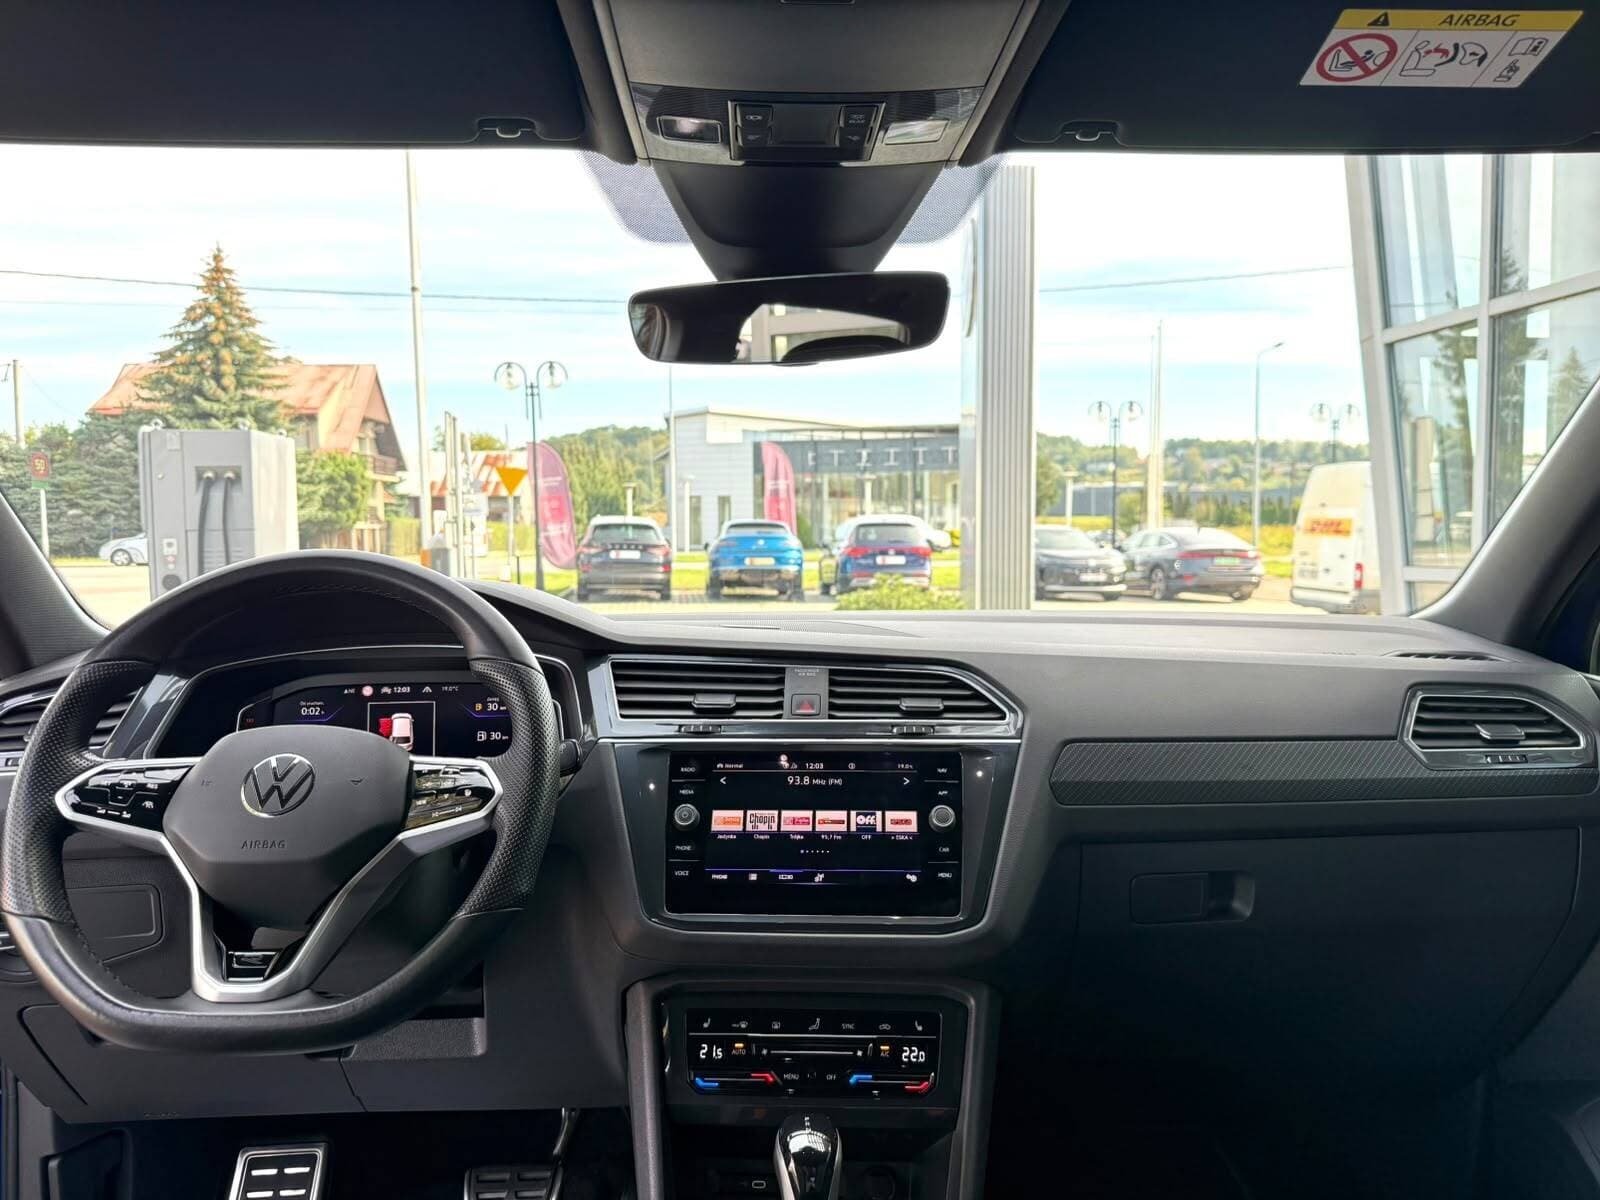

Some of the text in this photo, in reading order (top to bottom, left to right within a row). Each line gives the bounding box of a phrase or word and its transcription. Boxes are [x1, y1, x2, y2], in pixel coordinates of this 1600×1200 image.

[1438, 14, 1521, 27] AIRBAG
[1310, 519, 1343, 533] DHL
[393, 686, 411, 694] 12:03
[487, 702, 499, 711] 30
[301, 707, 321, 716] 0:02
[489, 731, 502, 740] 30
[787, 776, 810, 785] 93.8
[828, 778, 843, 786] (FM)
[749, 813, 775, 830] Chopin
[241, 839, 286, 851] AIRBAG
[841, 1022, 856, 1030] SYNC
[826, 1073, 837, 1081] OFF
